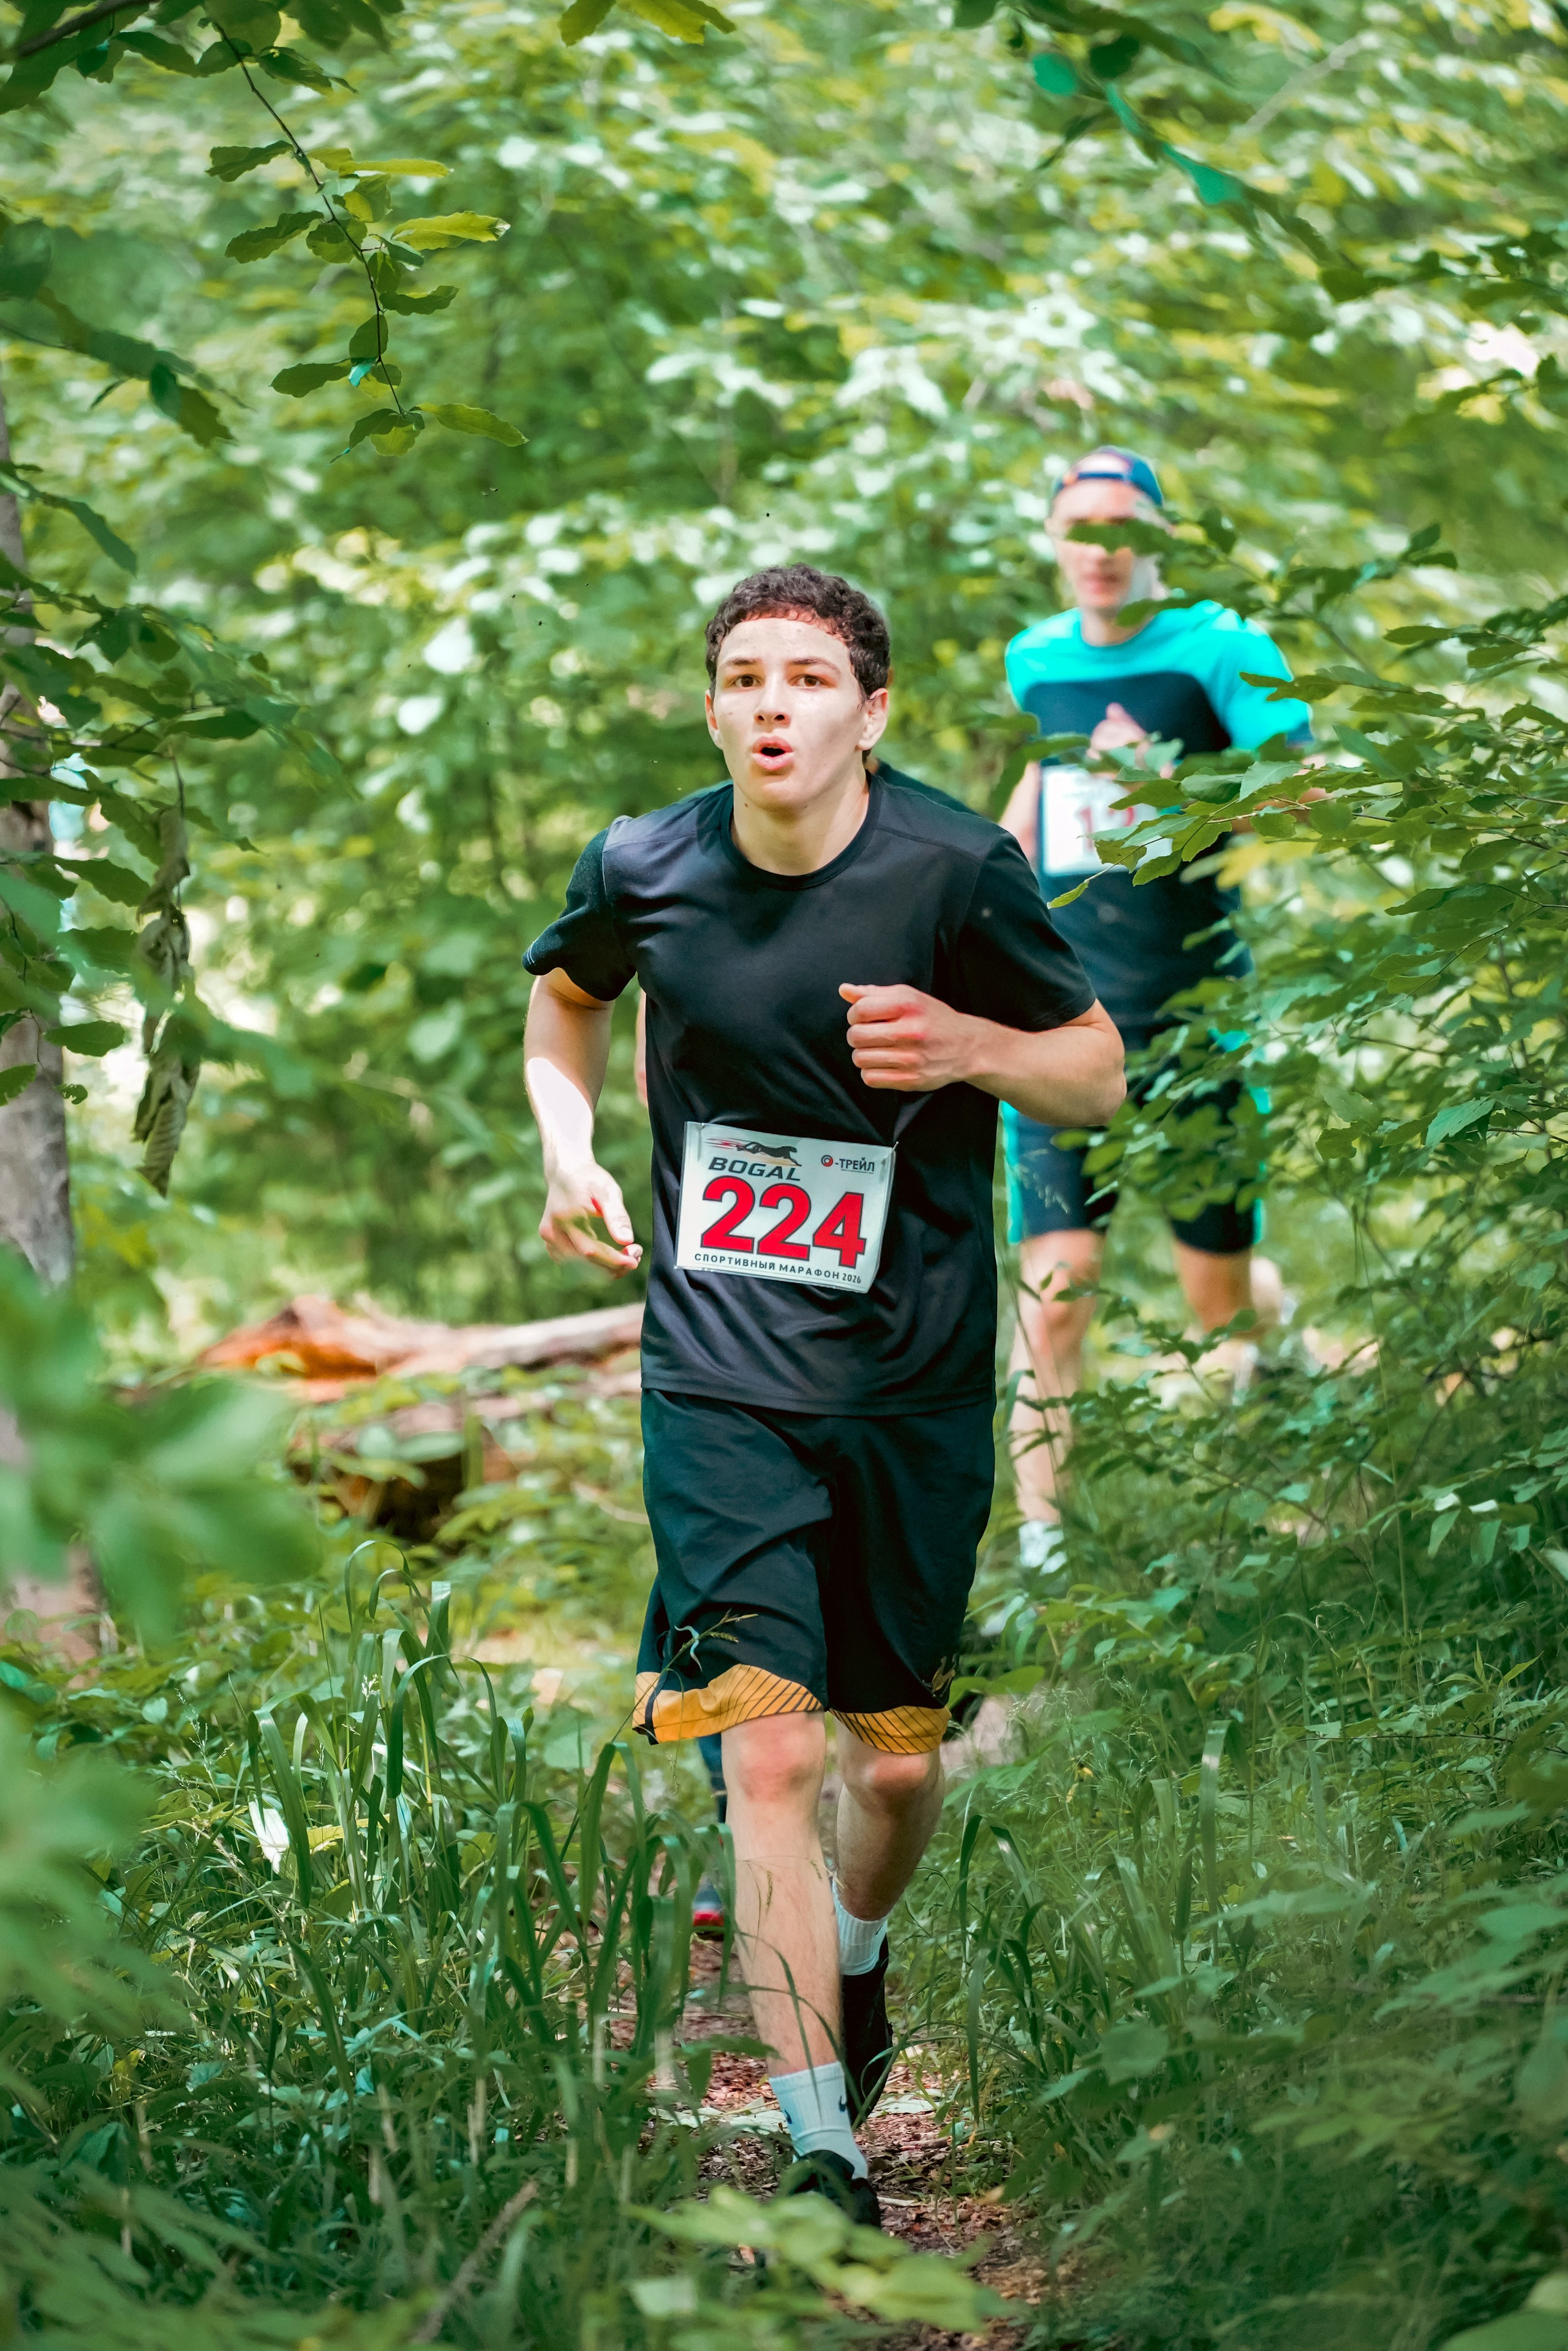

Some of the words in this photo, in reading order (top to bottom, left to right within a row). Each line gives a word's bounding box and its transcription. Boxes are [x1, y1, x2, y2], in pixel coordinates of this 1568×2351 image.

[709, 1157, 801, 1181] BOGAL
[700, 1176, 867, 1269] 224
[695, 1253, 775, 1270] СПОРТИВНЫЙ
[779, 1264, 839, 1279] МАРАФОН
[842, 1273, 861, 1284] 2026
